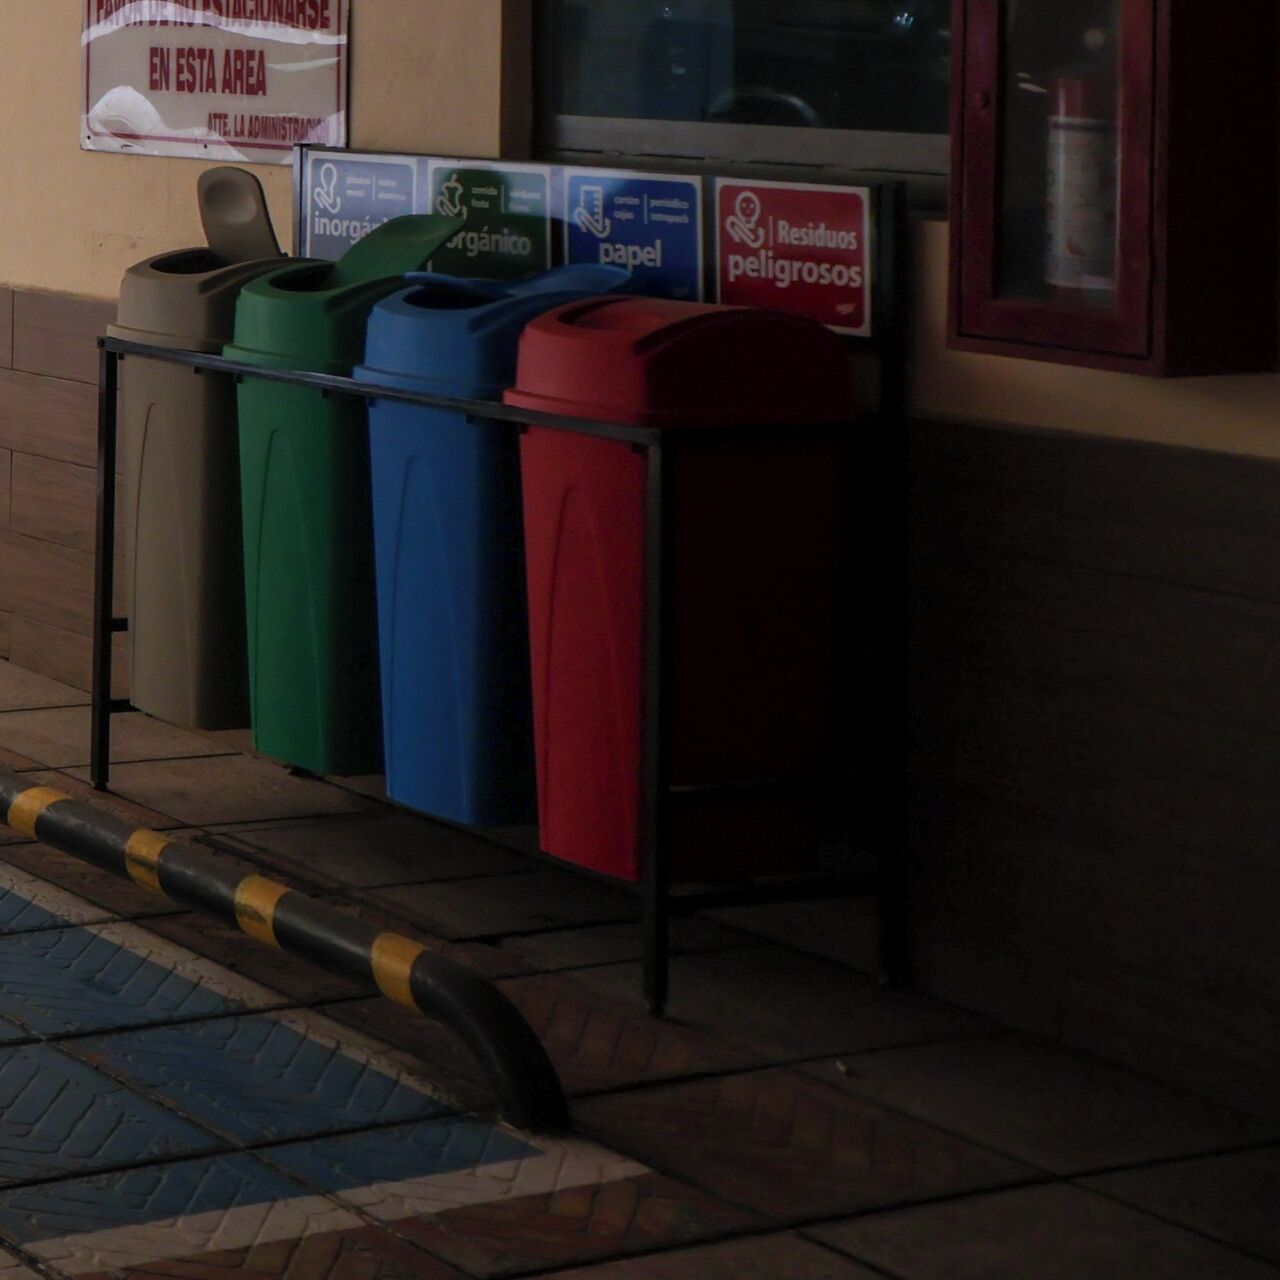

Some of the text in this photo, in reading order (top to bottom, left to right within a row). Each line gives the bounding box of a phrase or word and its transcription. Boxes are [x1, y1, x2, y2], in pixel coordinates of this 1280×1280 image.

[149, 46, 268, 97] EN ESTA AREA
[234, 115, 246, 138] LA
[313, 210, 389, 245] inorgá
[777, 222, 858, 251] Residuos
[599, 239, 662, 270] papel
[728, 249, 863, 289] peligrosos
